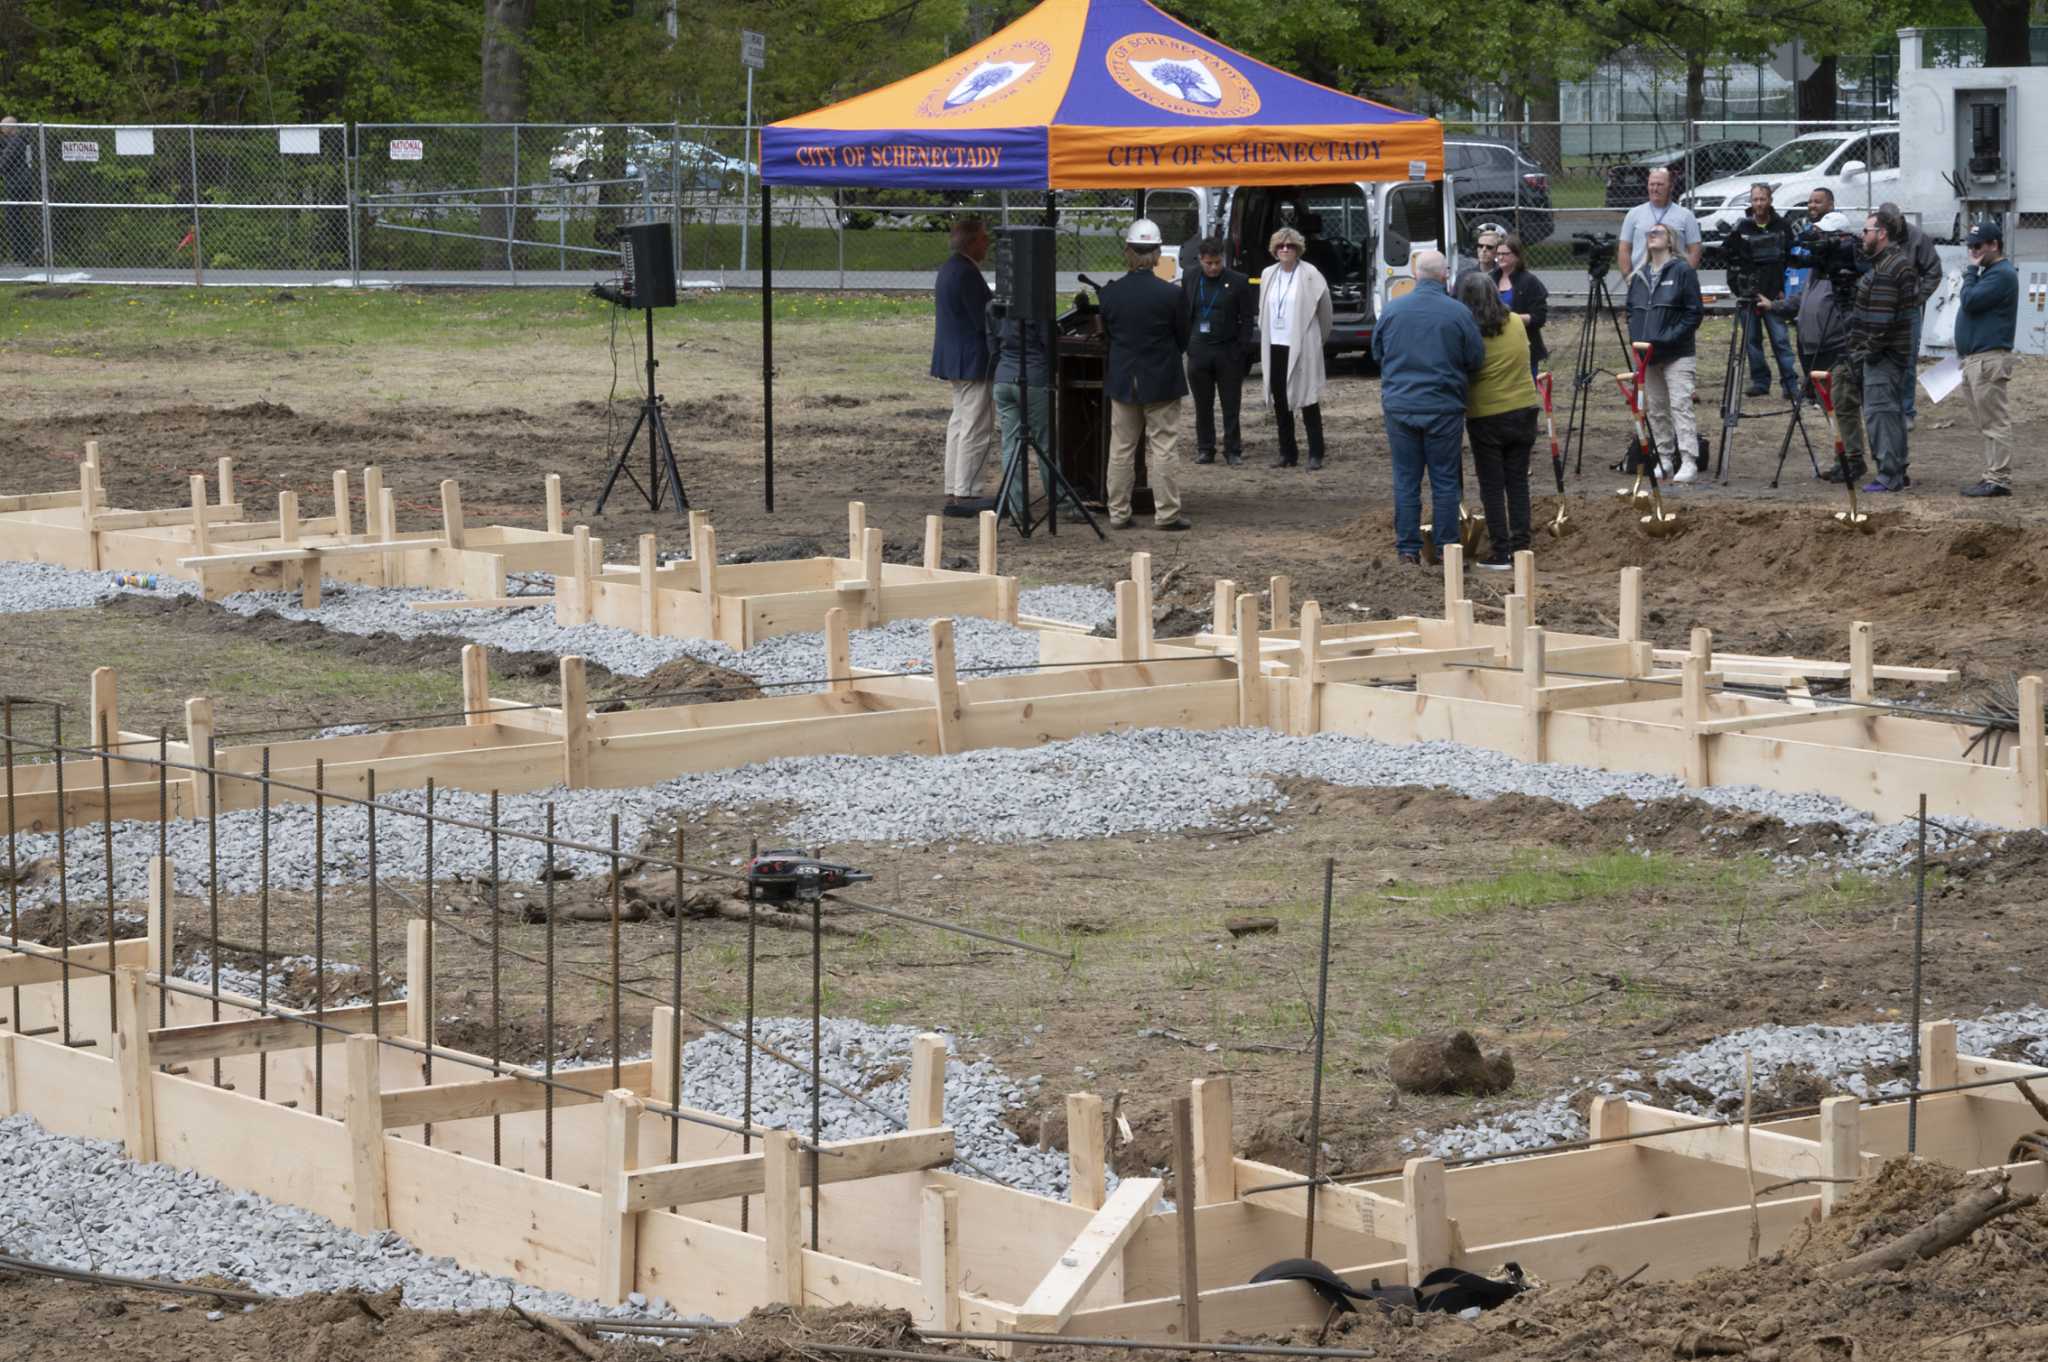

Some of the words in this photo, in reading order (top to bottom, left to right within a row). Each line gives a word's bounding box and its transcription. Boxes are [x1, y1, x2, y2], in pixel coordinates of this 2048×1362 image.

[64, 143, 96, 152] NATIONAL
[796, 146, 837, 167] CITY
[841, 146, 866, 167] OF
[871, 145, 1003, 168] SCHENECTADY
[1107, 144, 1165, 167] CITY
[1172, 143, 1206, 166] OF
[1212, 140, 1387, 165] SCHENECTADY
